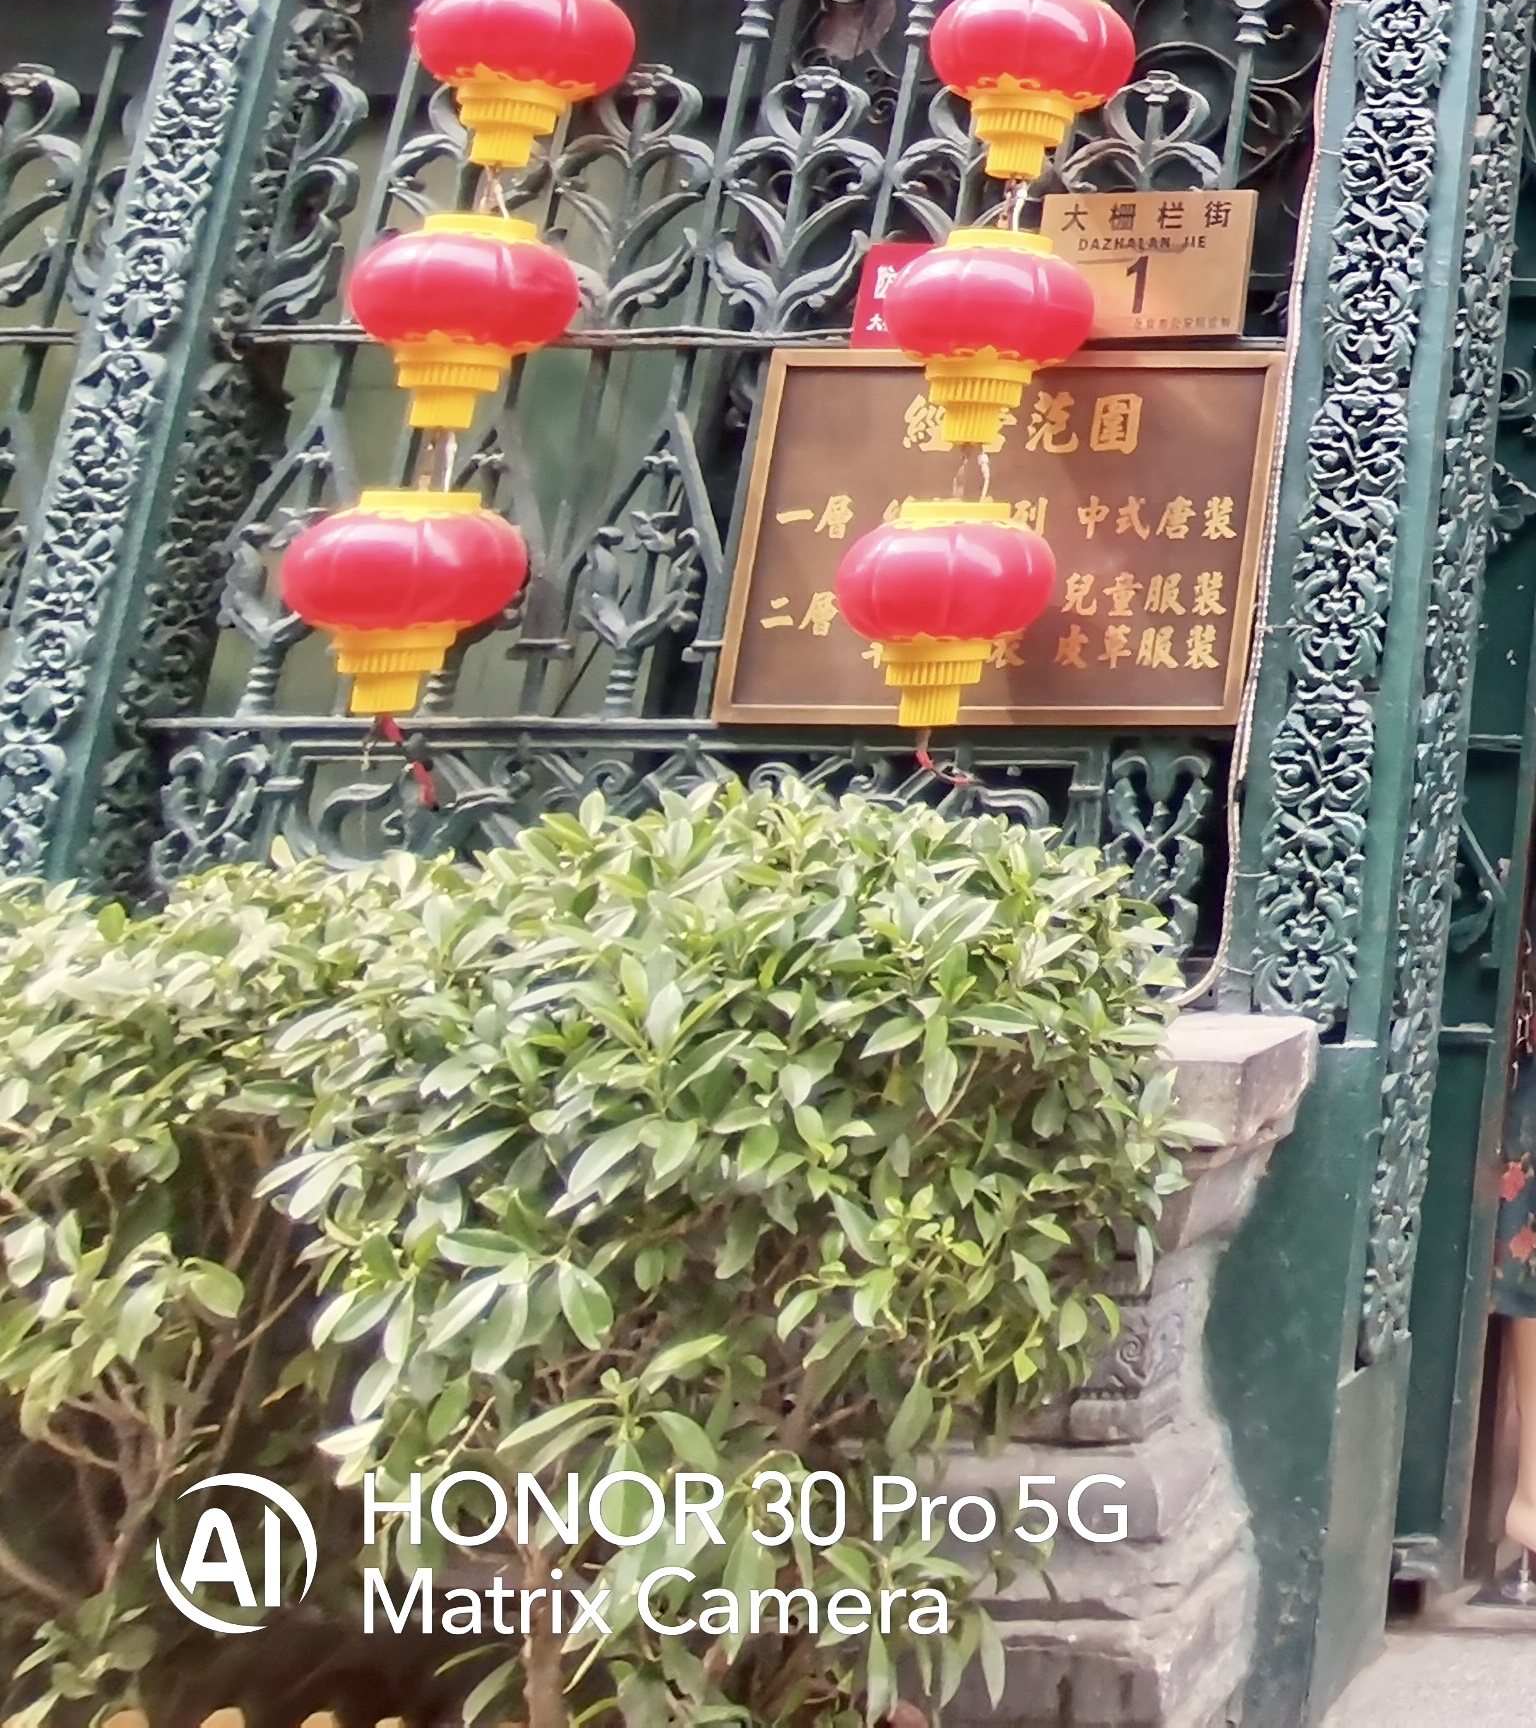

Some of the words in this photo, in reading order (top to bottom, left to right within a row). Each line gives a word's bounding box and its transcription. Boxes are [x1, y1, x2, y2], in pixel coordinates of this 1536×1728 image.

[1061, 200, 1232, 232] 大栅栏街
[1078, 236, 1172, 252] DAZHALAN
[1182, 234, 1207, 250] JIE
[1125, 255, 1148, 317] 1
[775, 494, 854, 541] 一層
[1077, 494, 1238, 541] 中式唐裝
[760, 592, 840, 637] 二層
[1061, 570, 1227, 617] 兒童服裝
